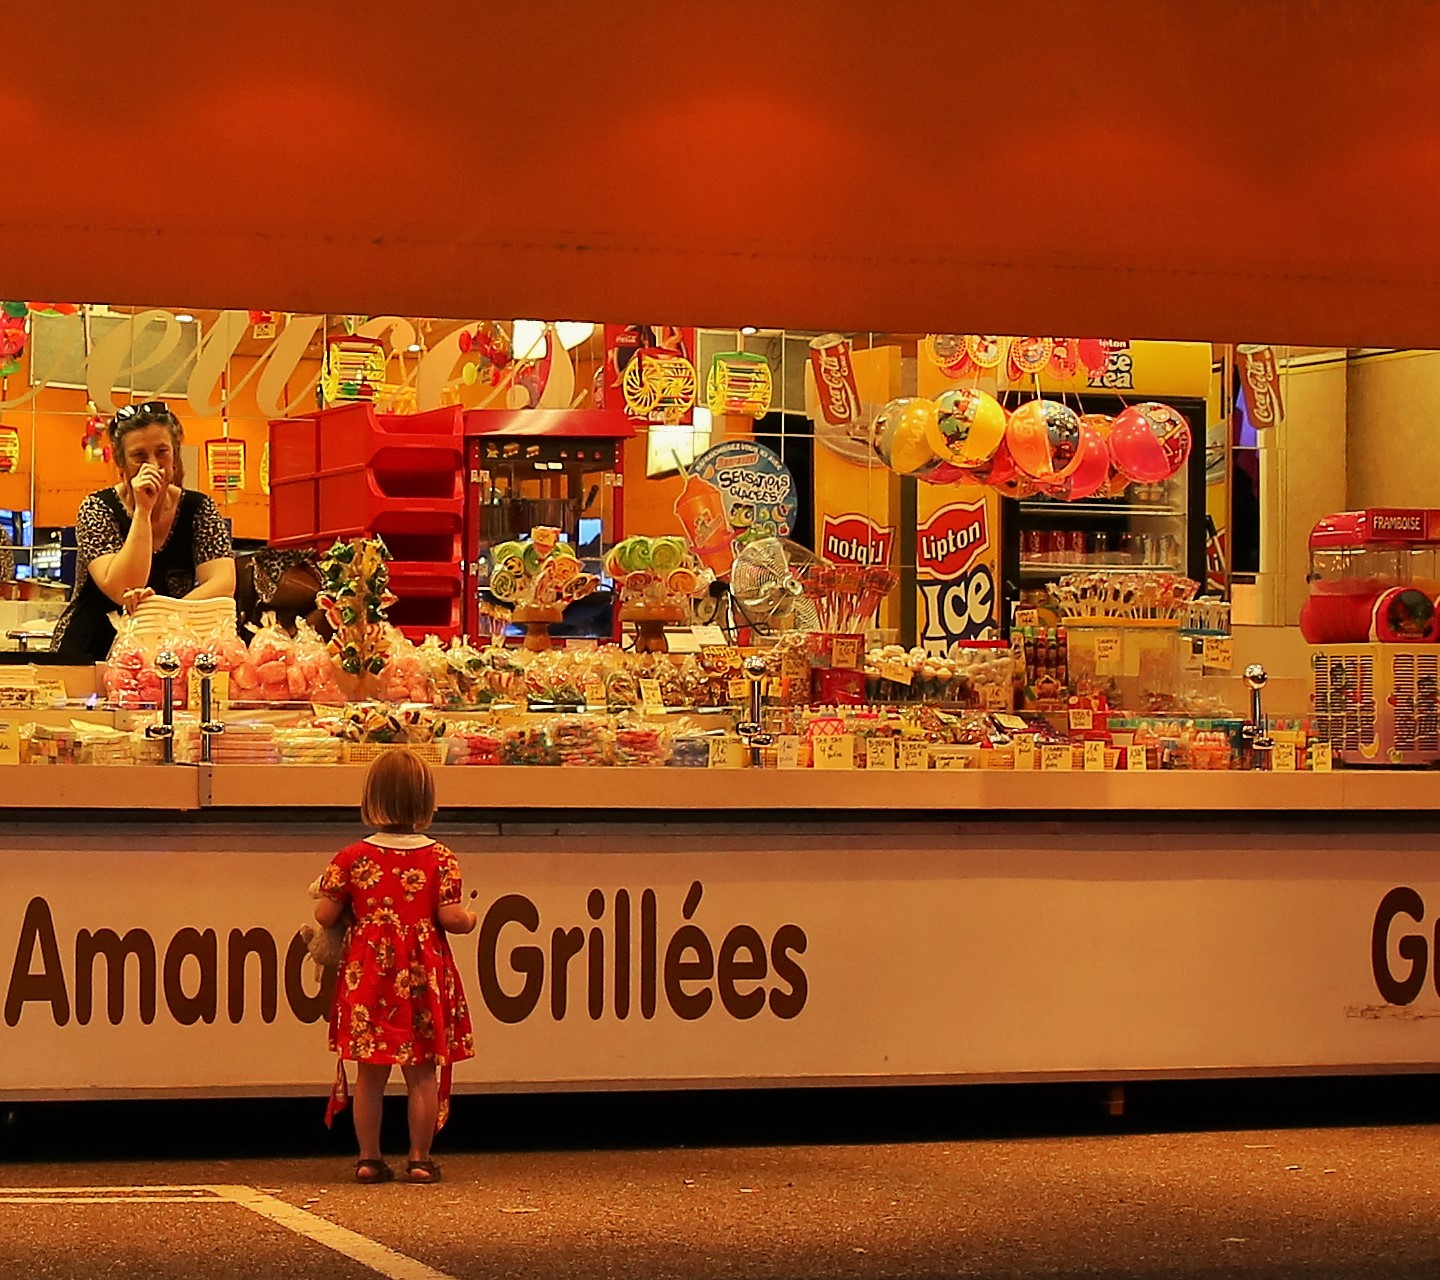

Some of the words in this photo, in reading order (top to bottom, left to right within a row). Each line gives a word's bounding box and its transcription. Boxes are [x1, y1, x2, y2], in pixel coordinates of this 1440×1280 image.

[1104, 354, 1132, 371] ce
[1373, 514, 1421, 531] FRAMBOISE
[922, 521, 981, 562] Lipton
[3, 895, 332, 1028] Aman
[476, 880, 810, 1026] Grillées
